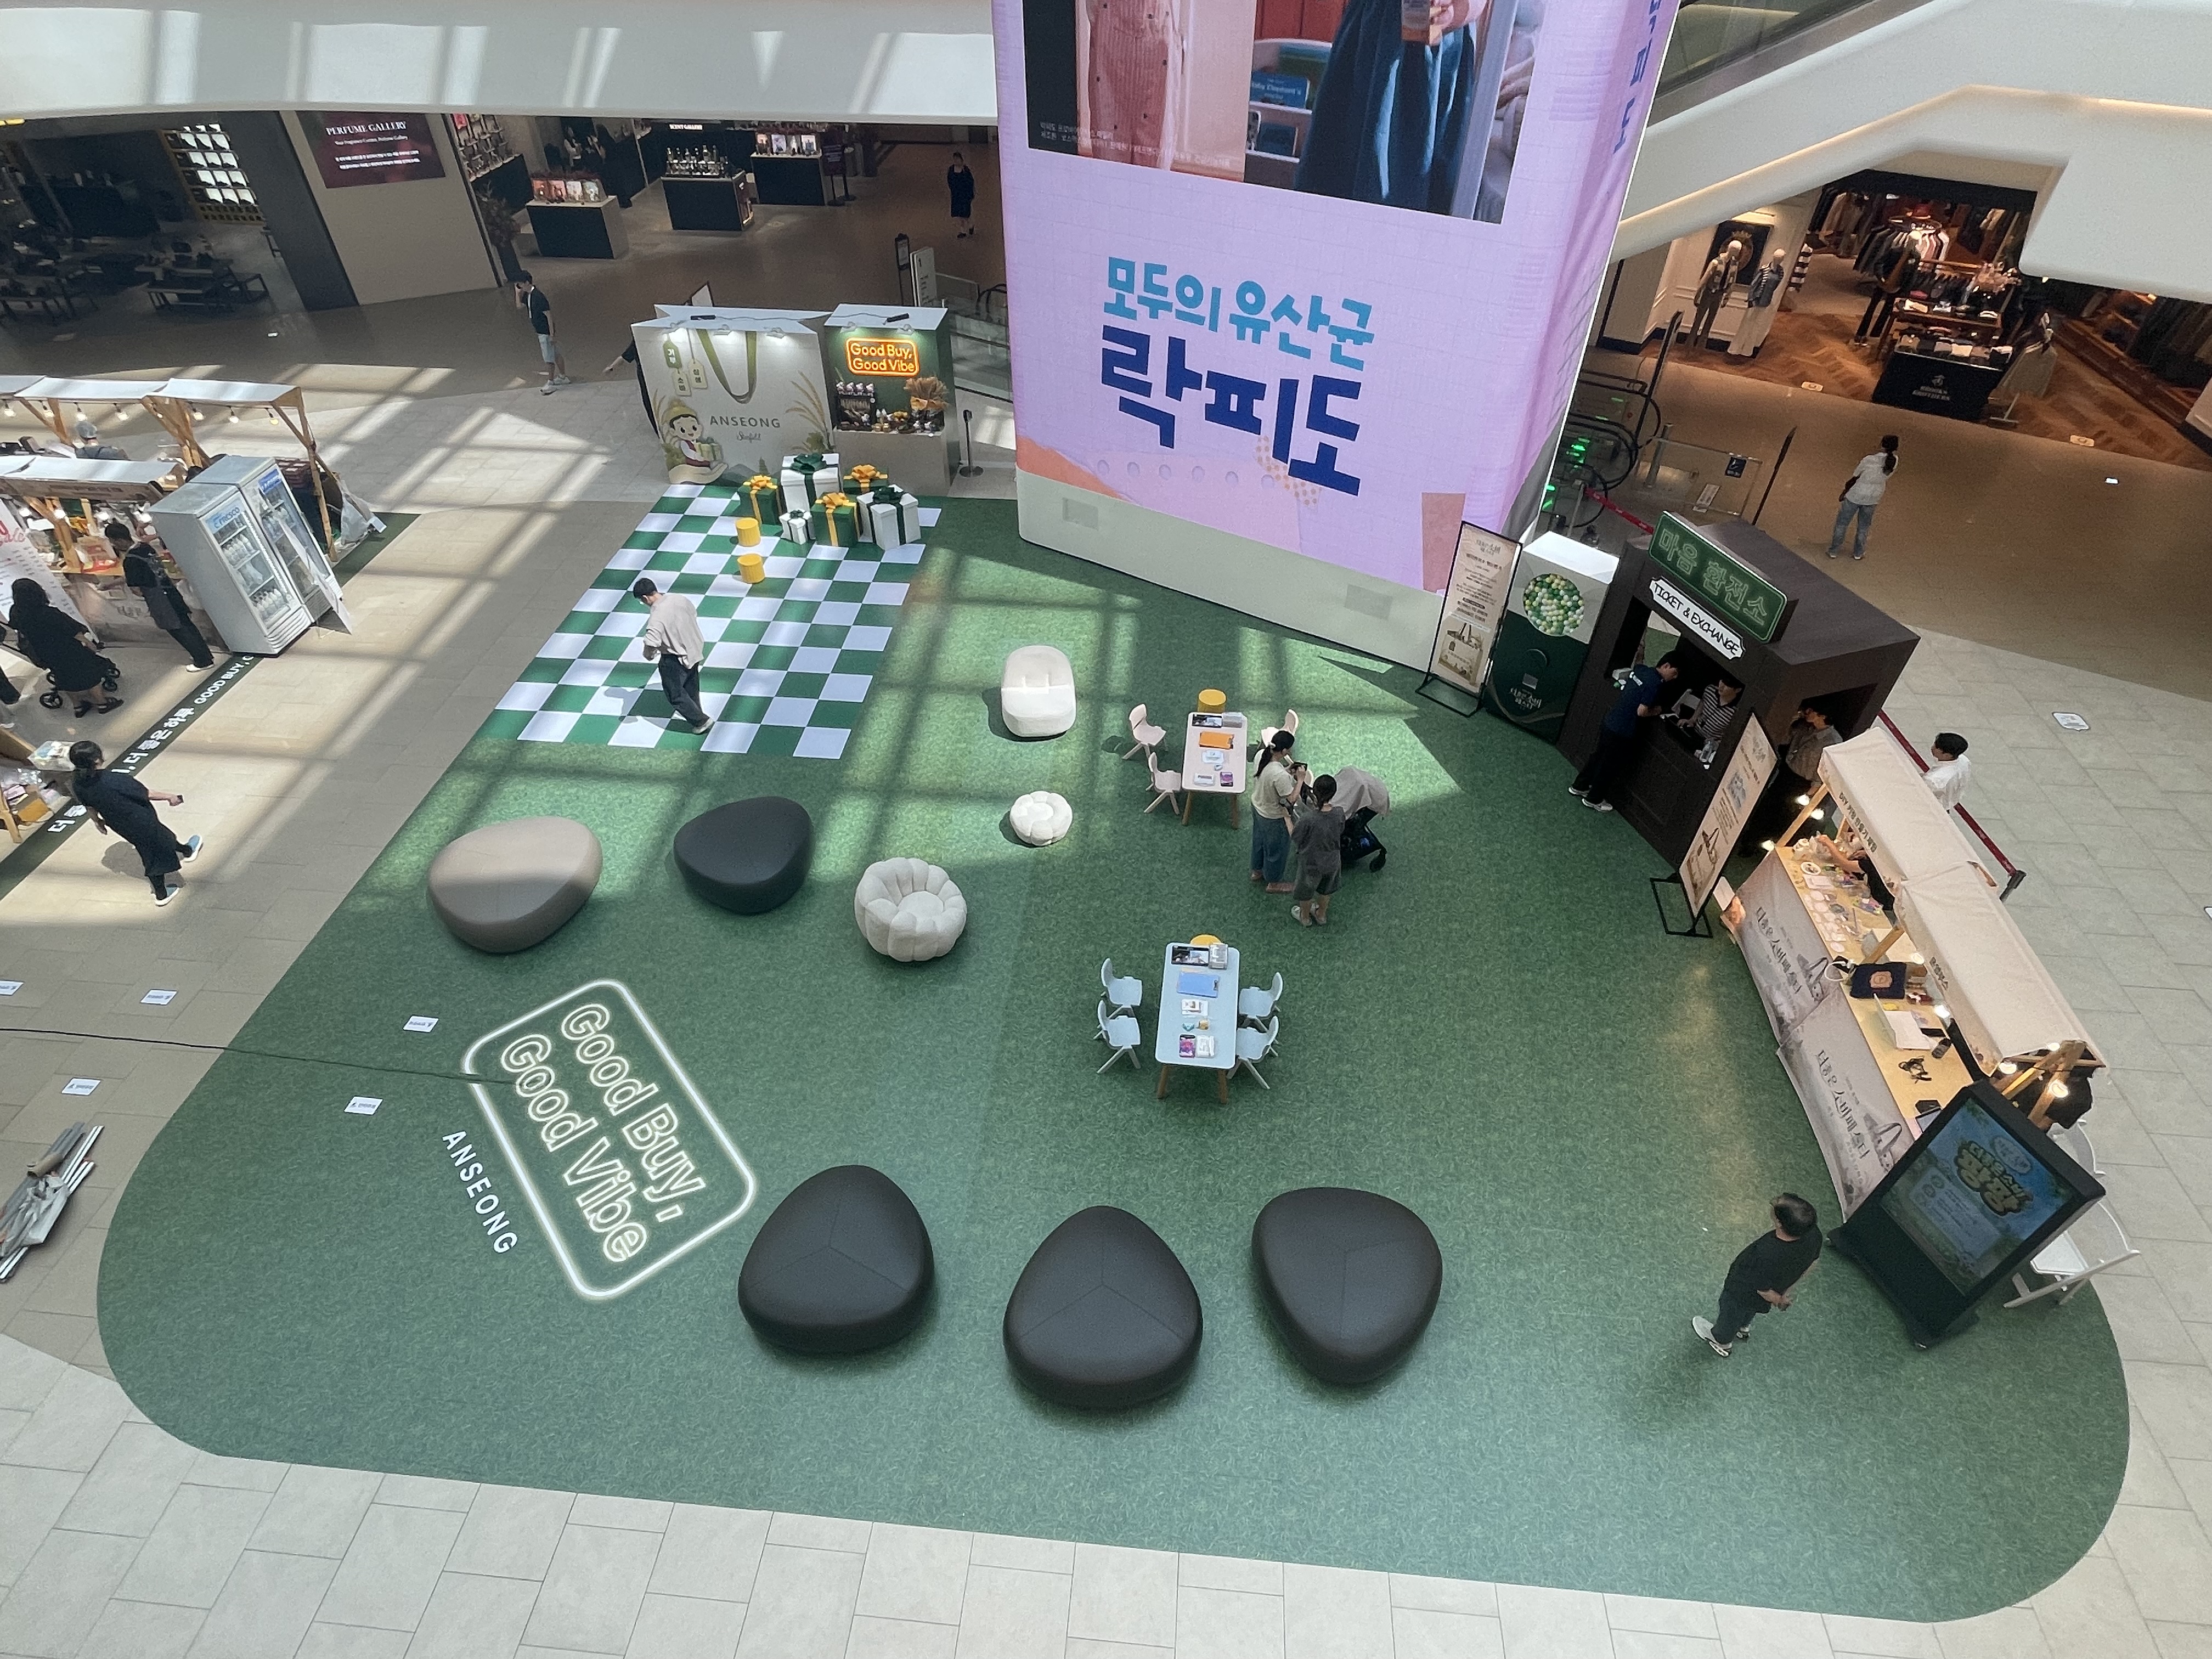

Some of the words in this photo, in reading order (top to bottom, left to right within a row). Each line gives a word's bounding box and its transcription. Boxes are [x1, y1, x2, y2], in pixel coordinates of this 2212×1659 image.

[326, 124, 367, 136] PERFUME
[368, 121, 407, 133] GALLERY
[1104, 256, 1221, 332] 모두의
[1228, 280, 1375, 371] 유산균
[850, 342, 885, 357] Good
[887, 344, 912, 360] Buy,
[853, 358, 887, 371] Good
[888, 359, 915, 372] Vibe
[709, 415, 781, 428] ANSEONG
[1101, 324, 1362, 496] 락피도
[1658, 528, 1698, 575] 마음
[1703, 560, 1767, 626] 환전소
[1654, 582, 1684, 611] TICKET
[1683, 607, 1690, 617] &
[1691, 612, 1740, 655] EXCHANGE
[194, 680, 226, 704] GOOD
[122, 751, 149, 764] 더
[163, 707, 195, 729] 하루
[500, 1034, 599, 1153] Good
[563, 1136, 649, 1263] Vibe
[561, 1002, 658, 1116] Good
[622, 1103, 707, 1223] Buy,
[442, 1130, 518, 1254] ANSEONG
